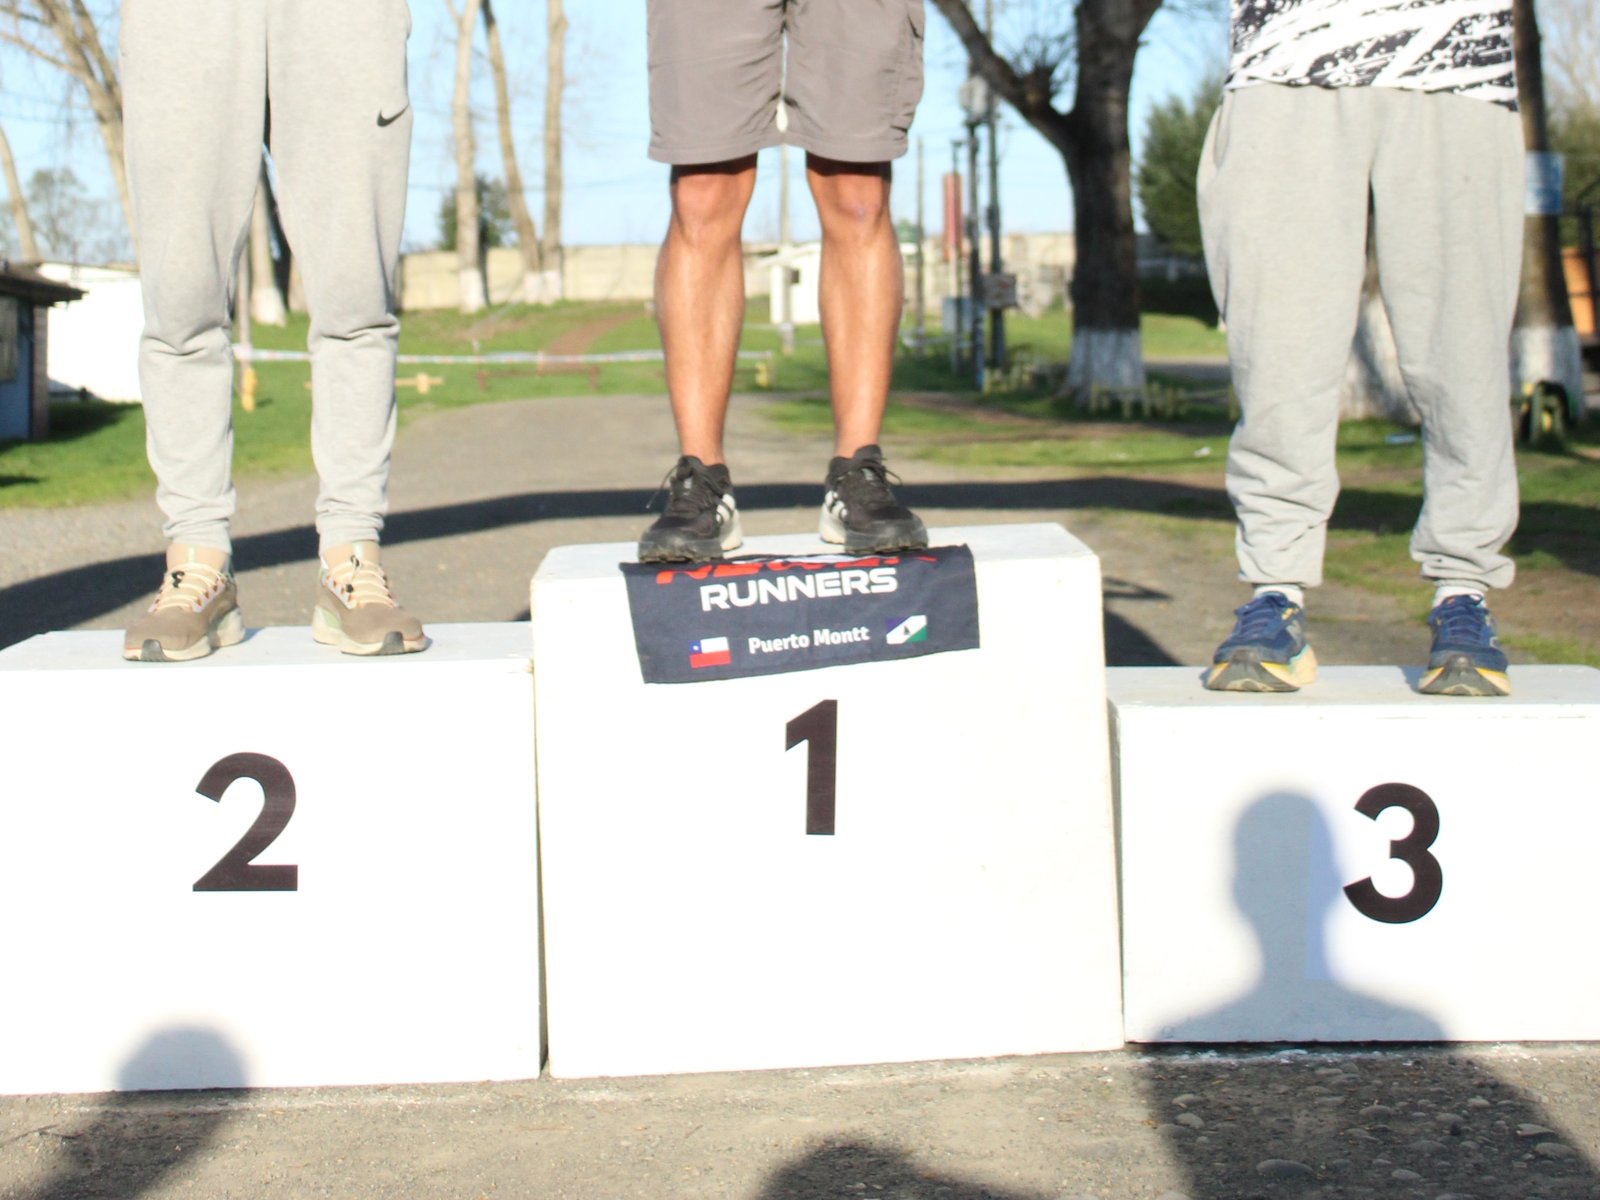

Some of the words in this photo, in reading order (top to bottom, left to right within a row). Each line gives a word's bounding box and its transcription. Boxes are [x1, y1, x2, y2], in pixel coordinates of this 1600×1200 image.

[699, 567, 899, 612] RUNNERS
[748, 631, 810, 655] Puerto
[813, 625, 871, 648] Montt
[192, 751, 299, 892] 2
[785, 699, 838, 837] 1
[1343, 782, 1443, 925] 3
